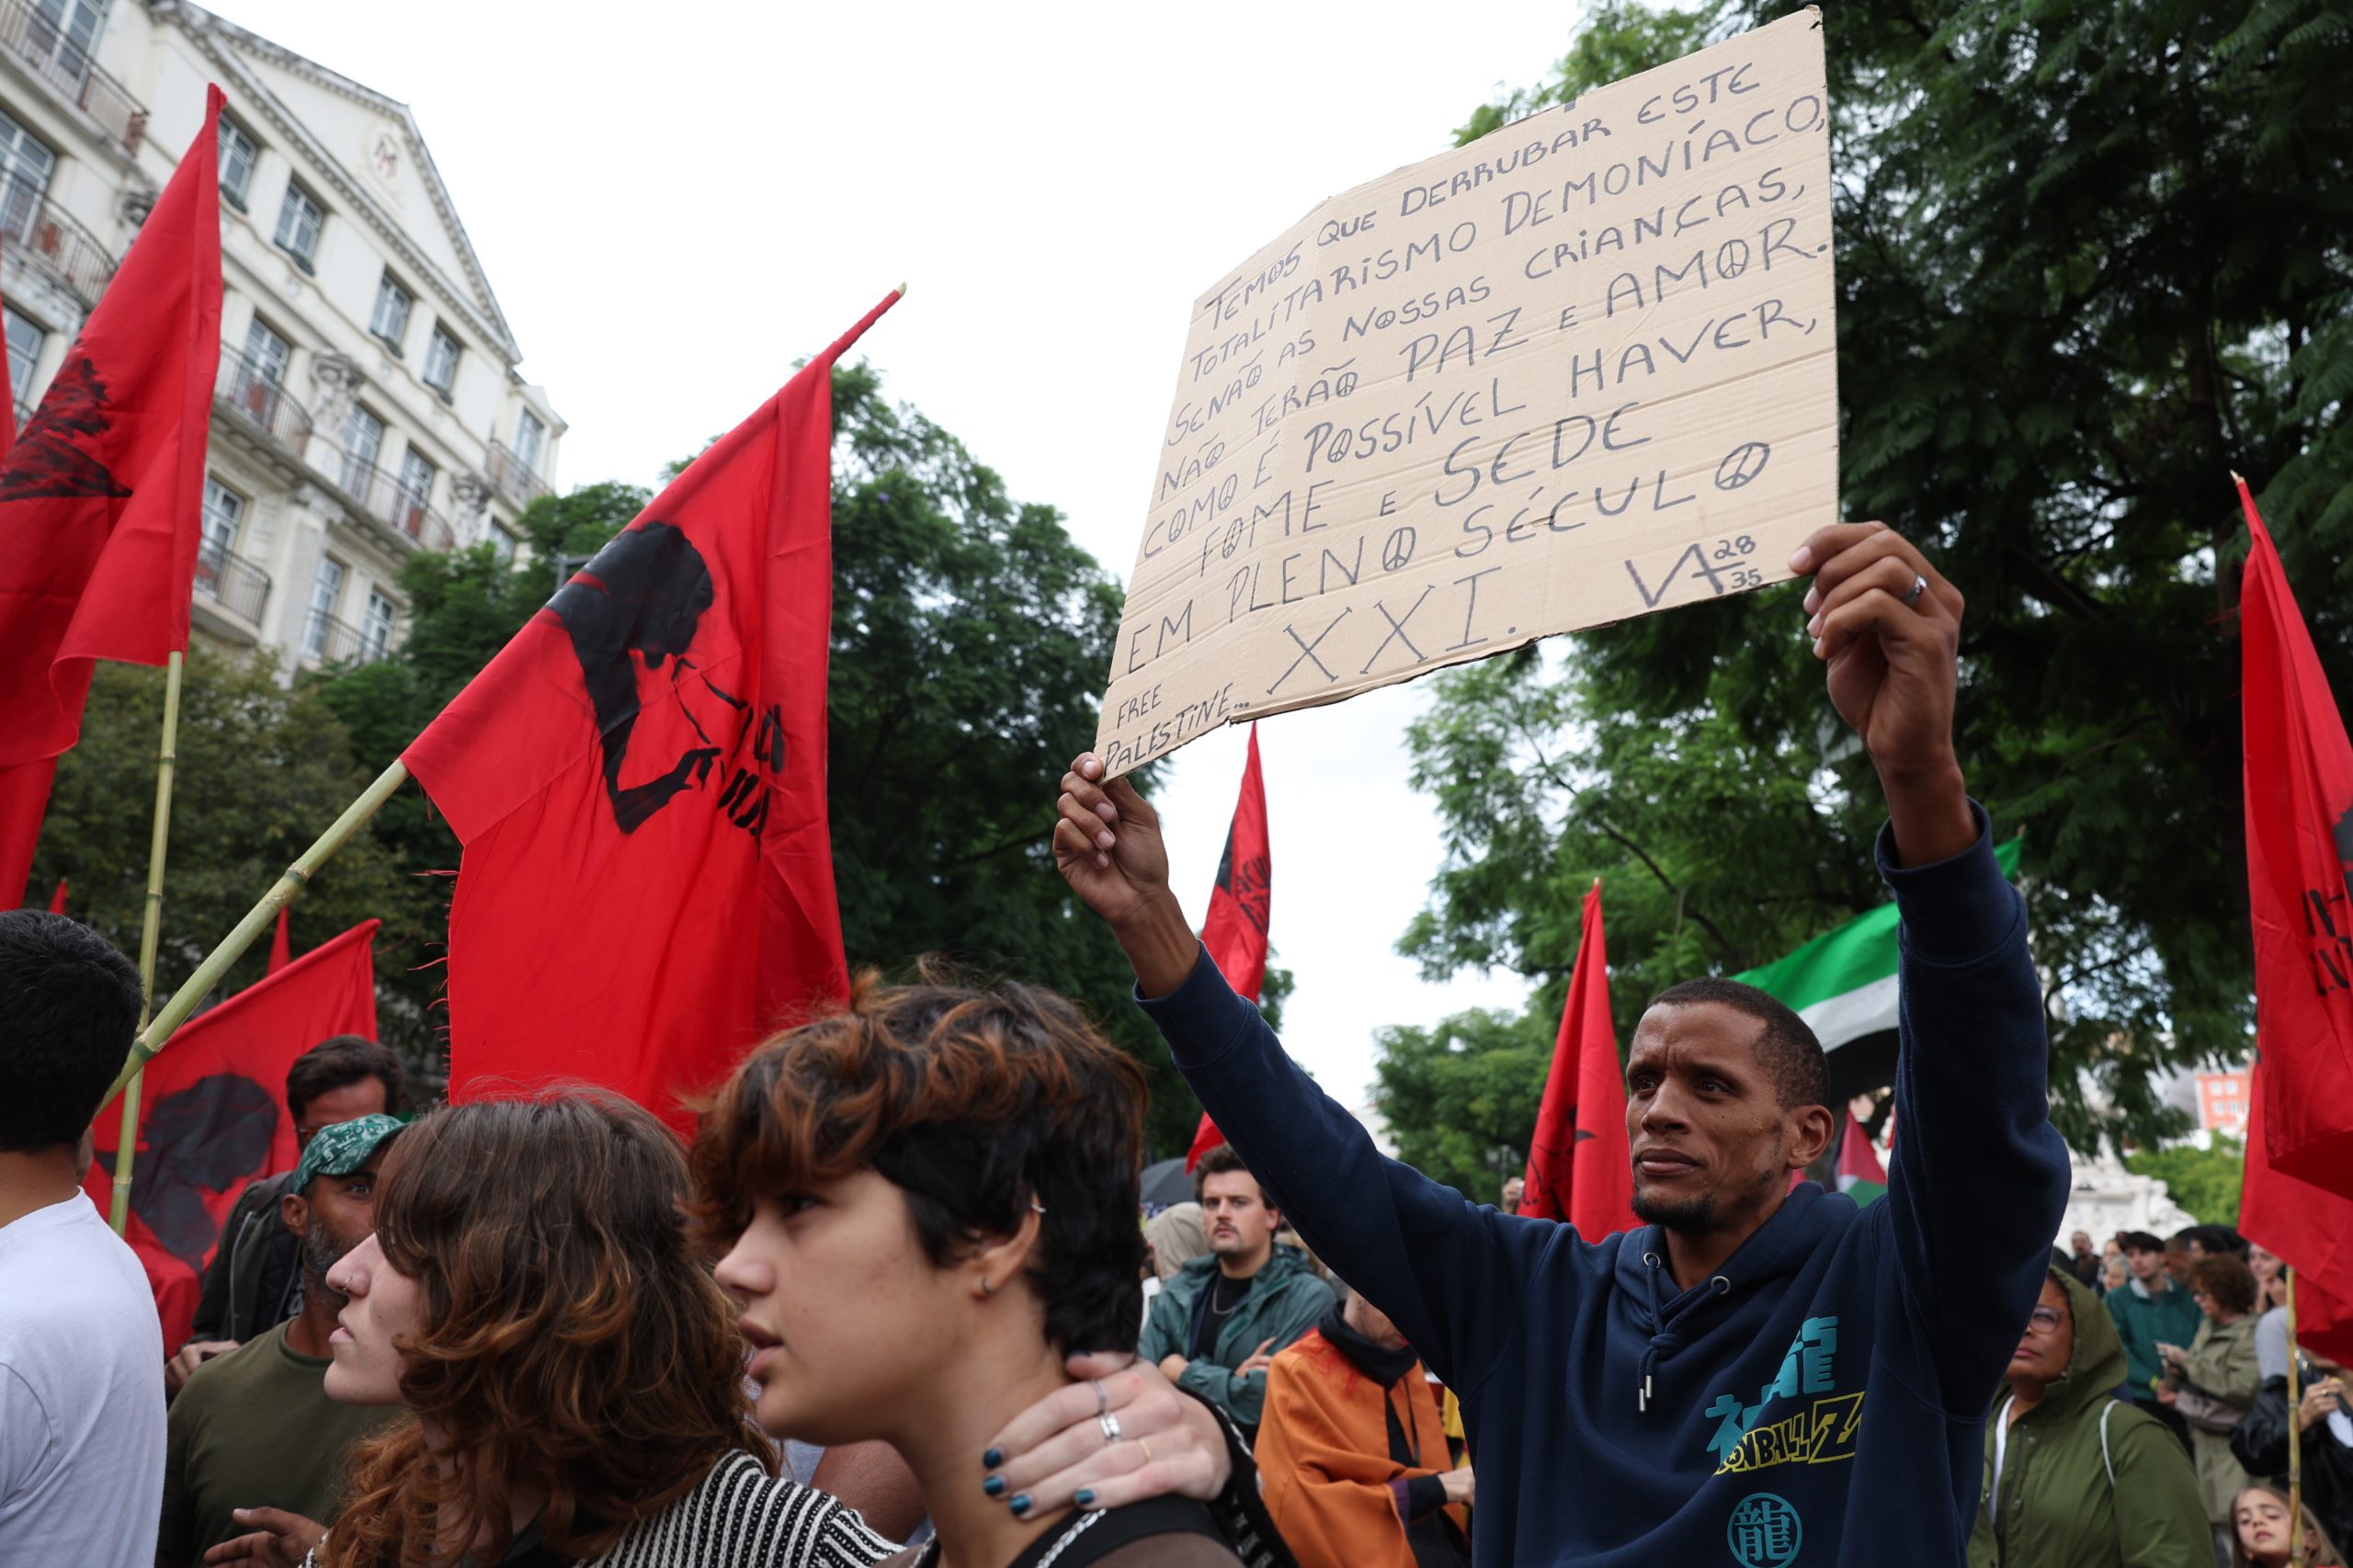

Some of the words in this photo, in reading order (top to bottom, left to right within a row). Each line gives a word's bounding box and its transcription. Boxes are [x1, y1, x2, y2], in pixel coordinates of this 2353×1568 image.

[1317, 210, 1377, 246] QUE
[1401, 118, 1611, 217] DERRUBAR
[1637, 62, 1760, 124] ESTE
[1502, 95, 1825, 235] DEMONÍACO,
[1160, 433, 1226, 501] NÃO
[1251, 357, 1358, 436] TERÃO
[1399, 307, 1529, 382] PAZ
[1607, 218, 1828, 318] AMOR.
[1279, 329, 1315, 367] AS
[1343, 277, 1491, 342] NOSSAS
[1142, 472, 1238, 559] COMO
[1253, 429, 1279, 489] É
[1303, 377, 1527, 472] POSSÍVEL
[1571, 300, 1816, 398] HAVER,
[1200, 479, 1335, 578] FOME
[1434, 402, 1652, 507] SEDE
[1128, 598, 1194, 675] EM
[1225, 526, 1416, 623] PLENO
[1266, 566, 1517, 695] XXI.
[1730, 568, 1764, 588] 35
[1117, 683, 1162, 730] FREE
